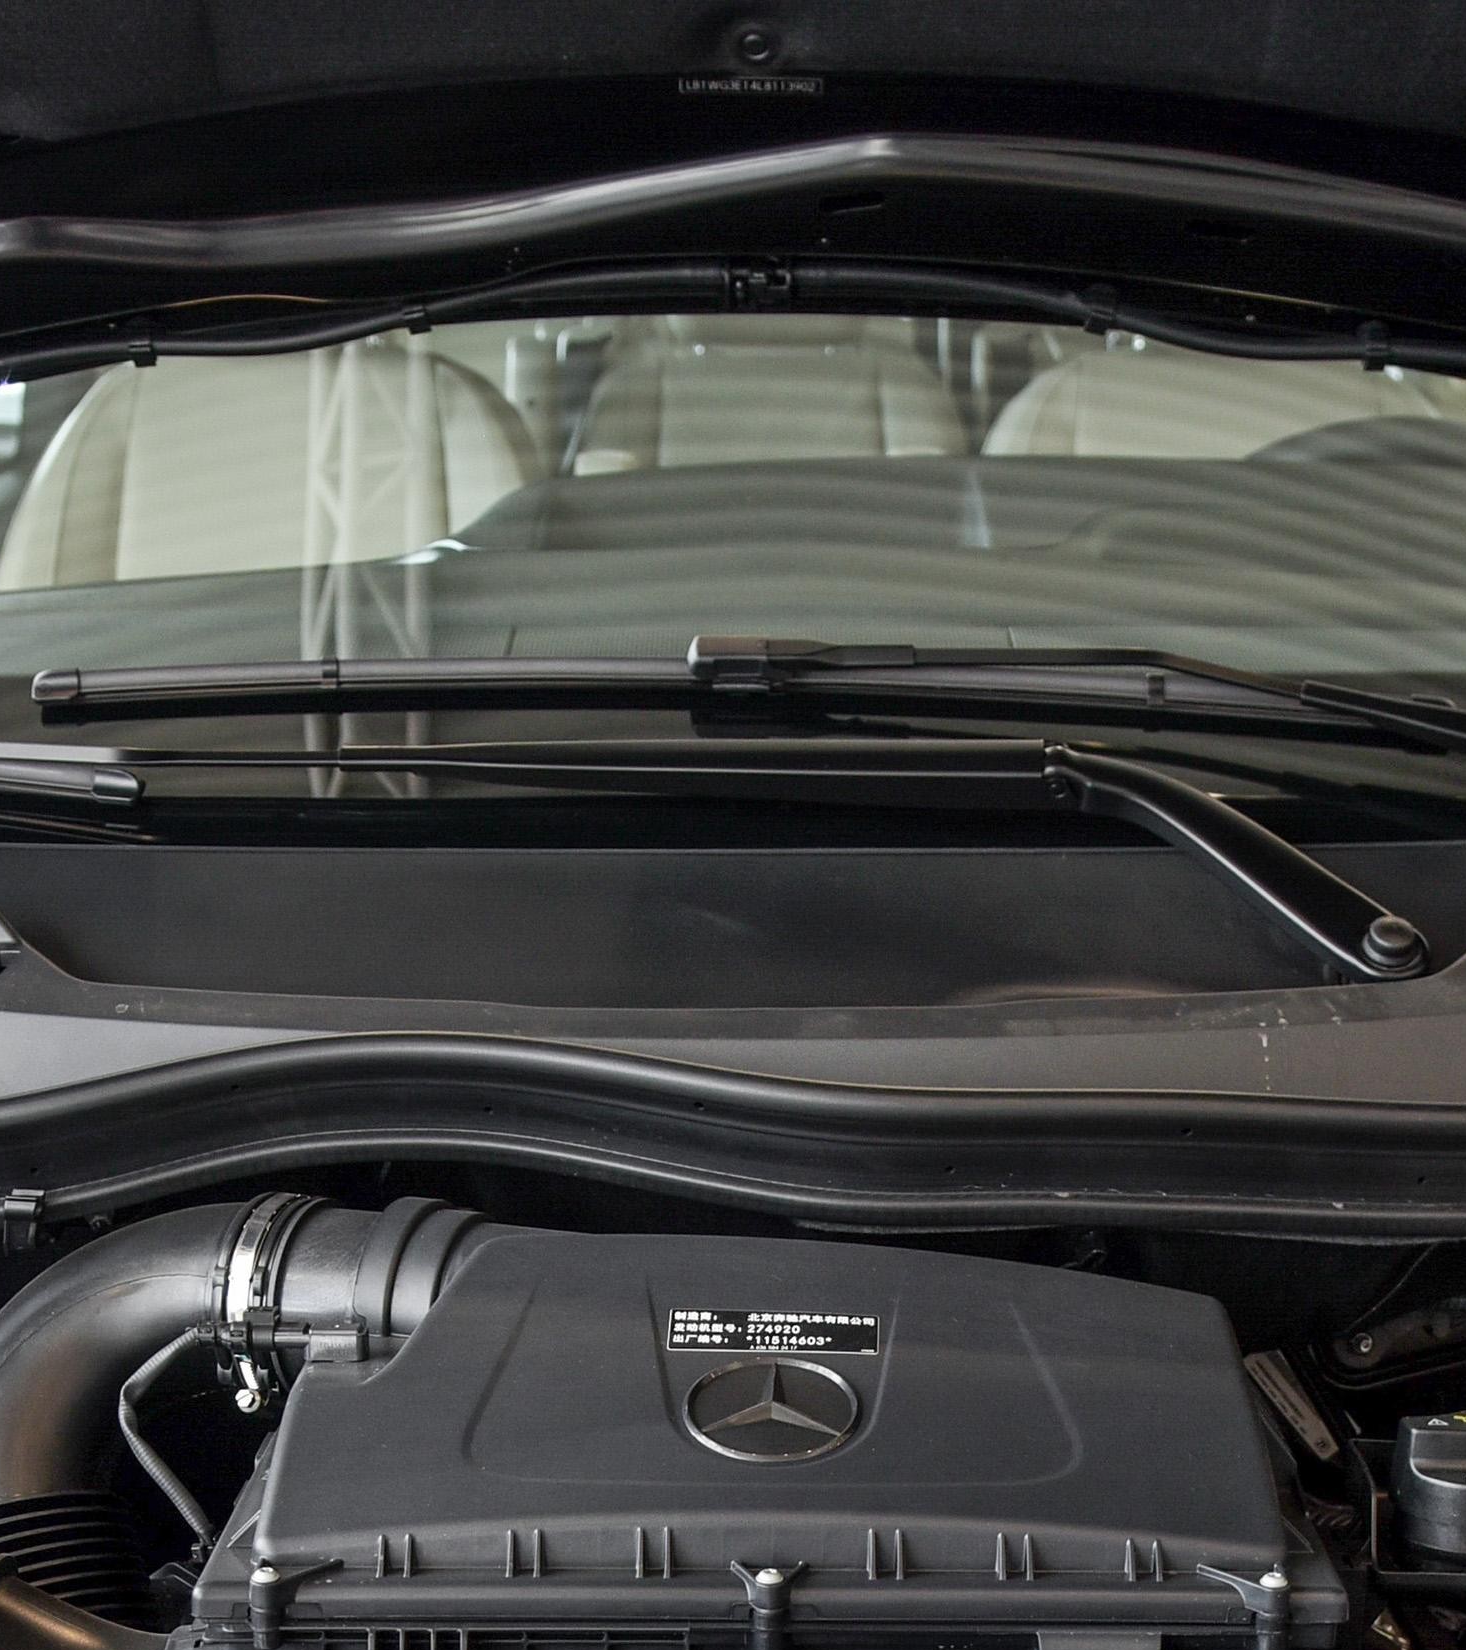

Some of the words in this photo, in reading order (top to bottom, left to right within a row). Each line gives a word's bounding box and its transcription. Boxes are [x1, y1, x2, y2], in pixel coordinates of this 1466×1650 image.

[747, 1313, 875, 1326] 北京奔驰汽车有限公司
[747, 1324, 801, 1334] 274920
